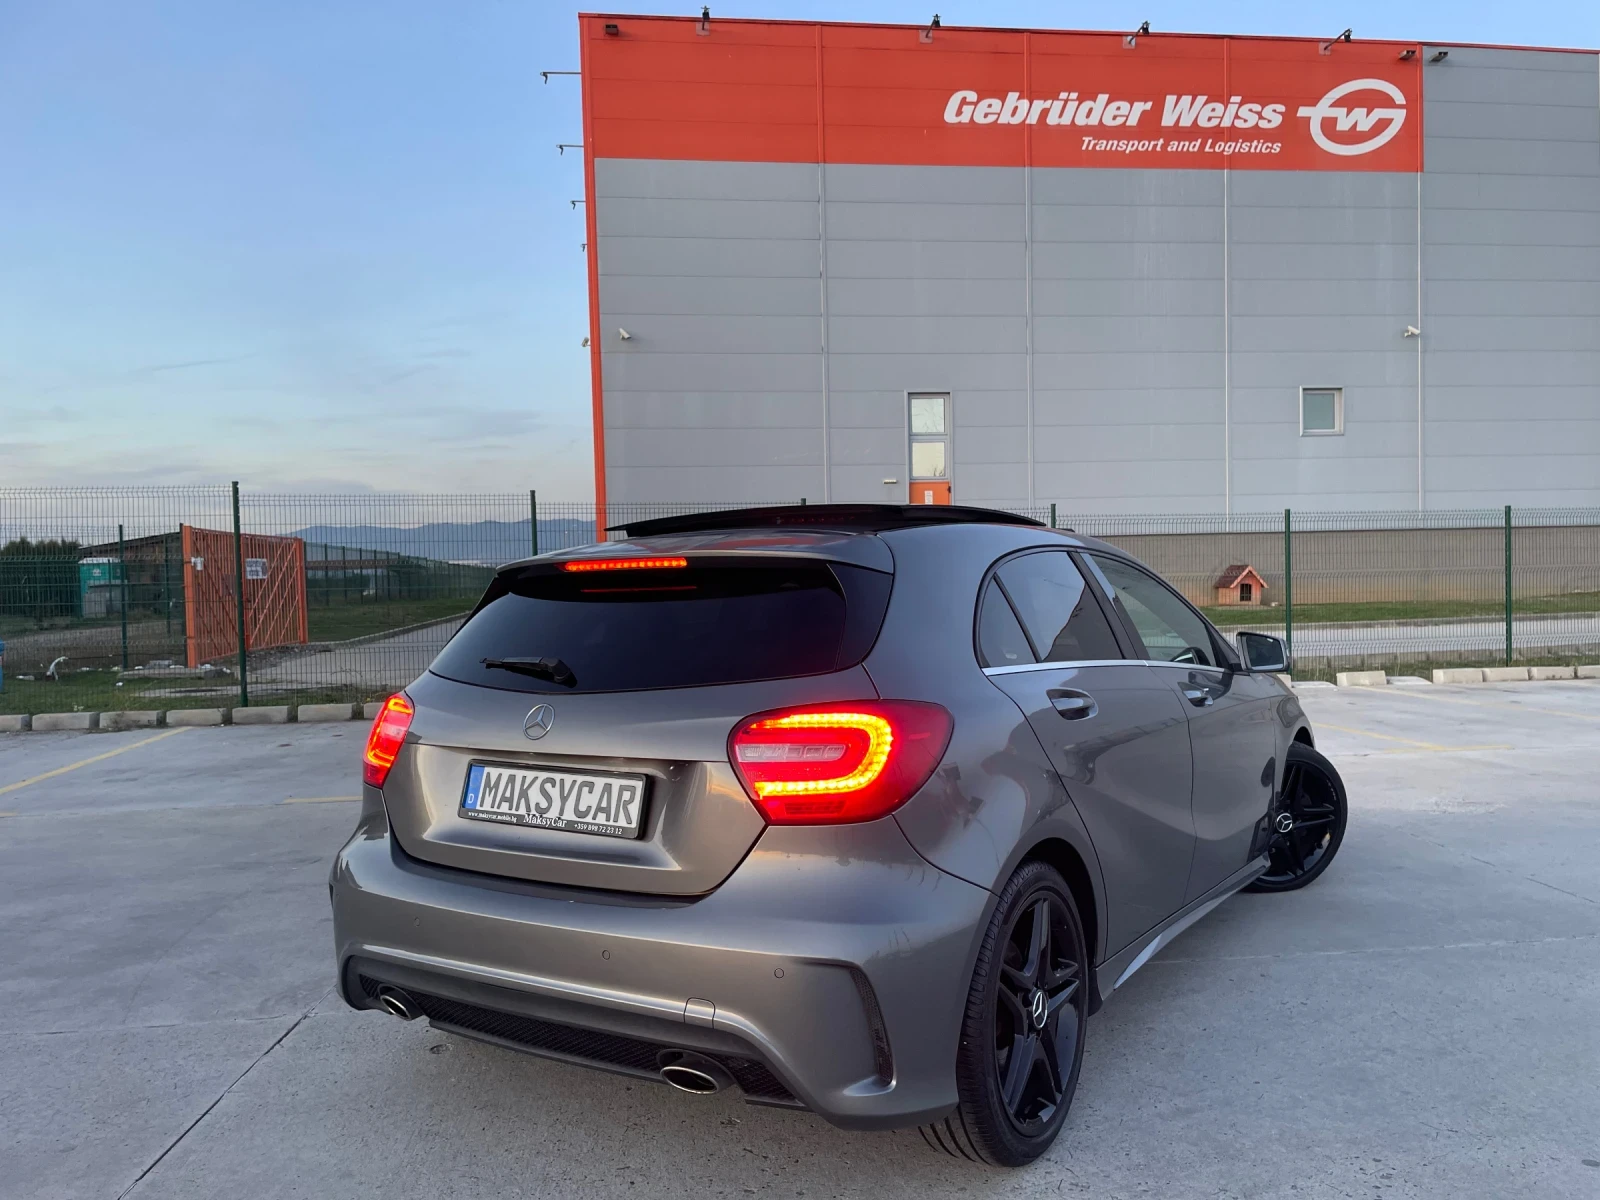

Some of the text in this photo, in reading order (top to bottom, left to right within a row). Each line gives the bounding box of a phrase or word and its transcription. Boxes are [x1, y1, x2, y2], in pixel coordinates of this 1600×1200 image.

[943, 90, 1286, 129] Gebrüder Weiss
[1081, 136, 1282, 155] Transport and Logistics
[467, 794, 474, 804] D
[479, 771, 637, 825] MAKSYCAR
[523, 813, 568, 828] MaksyCar
